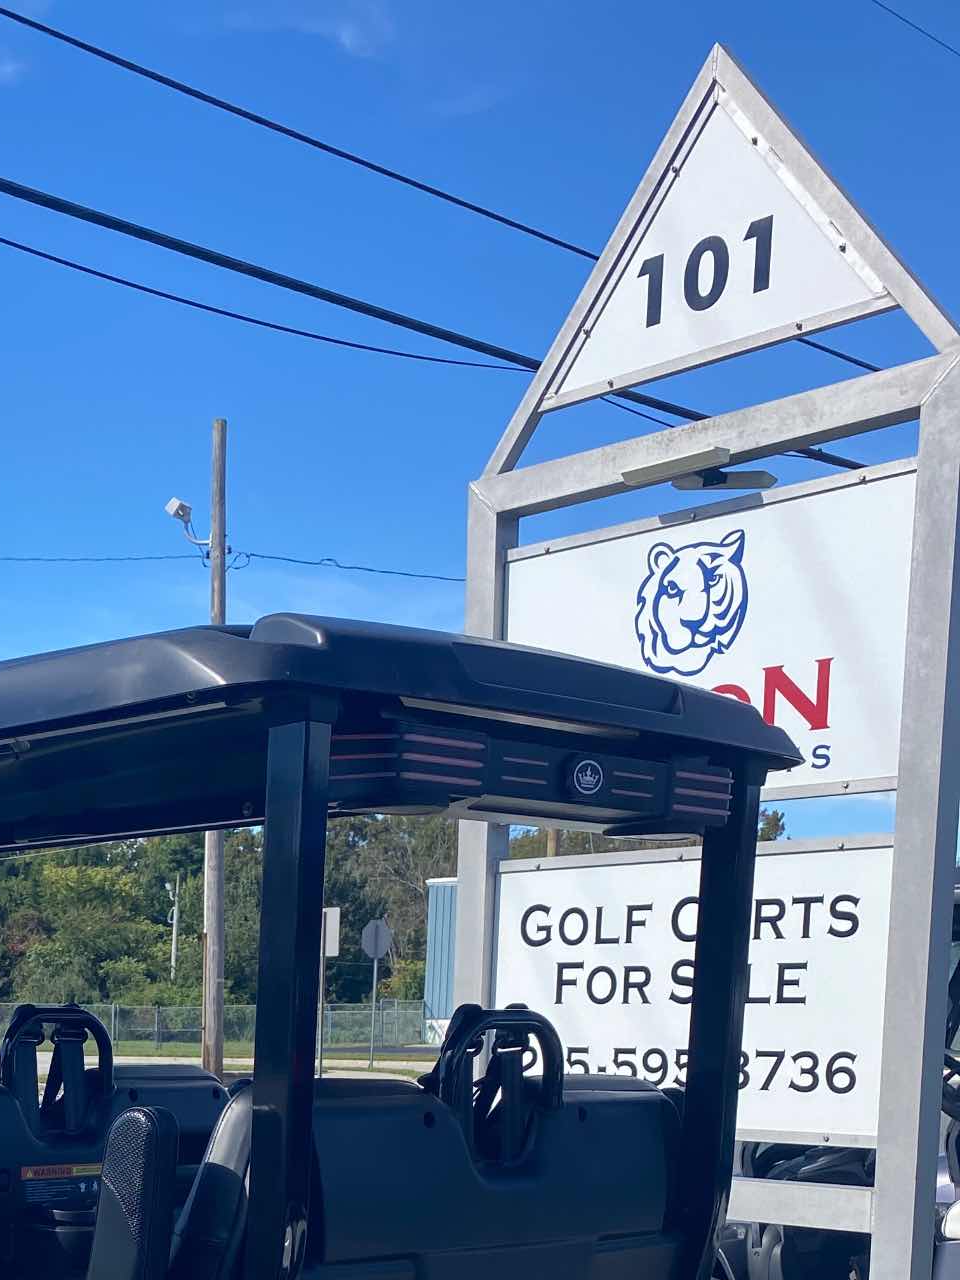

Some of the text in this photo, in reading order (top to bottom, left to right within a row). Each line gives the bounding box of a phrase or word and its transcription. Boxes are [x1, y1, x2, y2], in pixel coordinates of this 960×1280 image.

[637, 214, 773, 328] 101
[520, 894, 861, 947] GOLF CRTS
[554, 958, 808, 1005] FOR SLE
